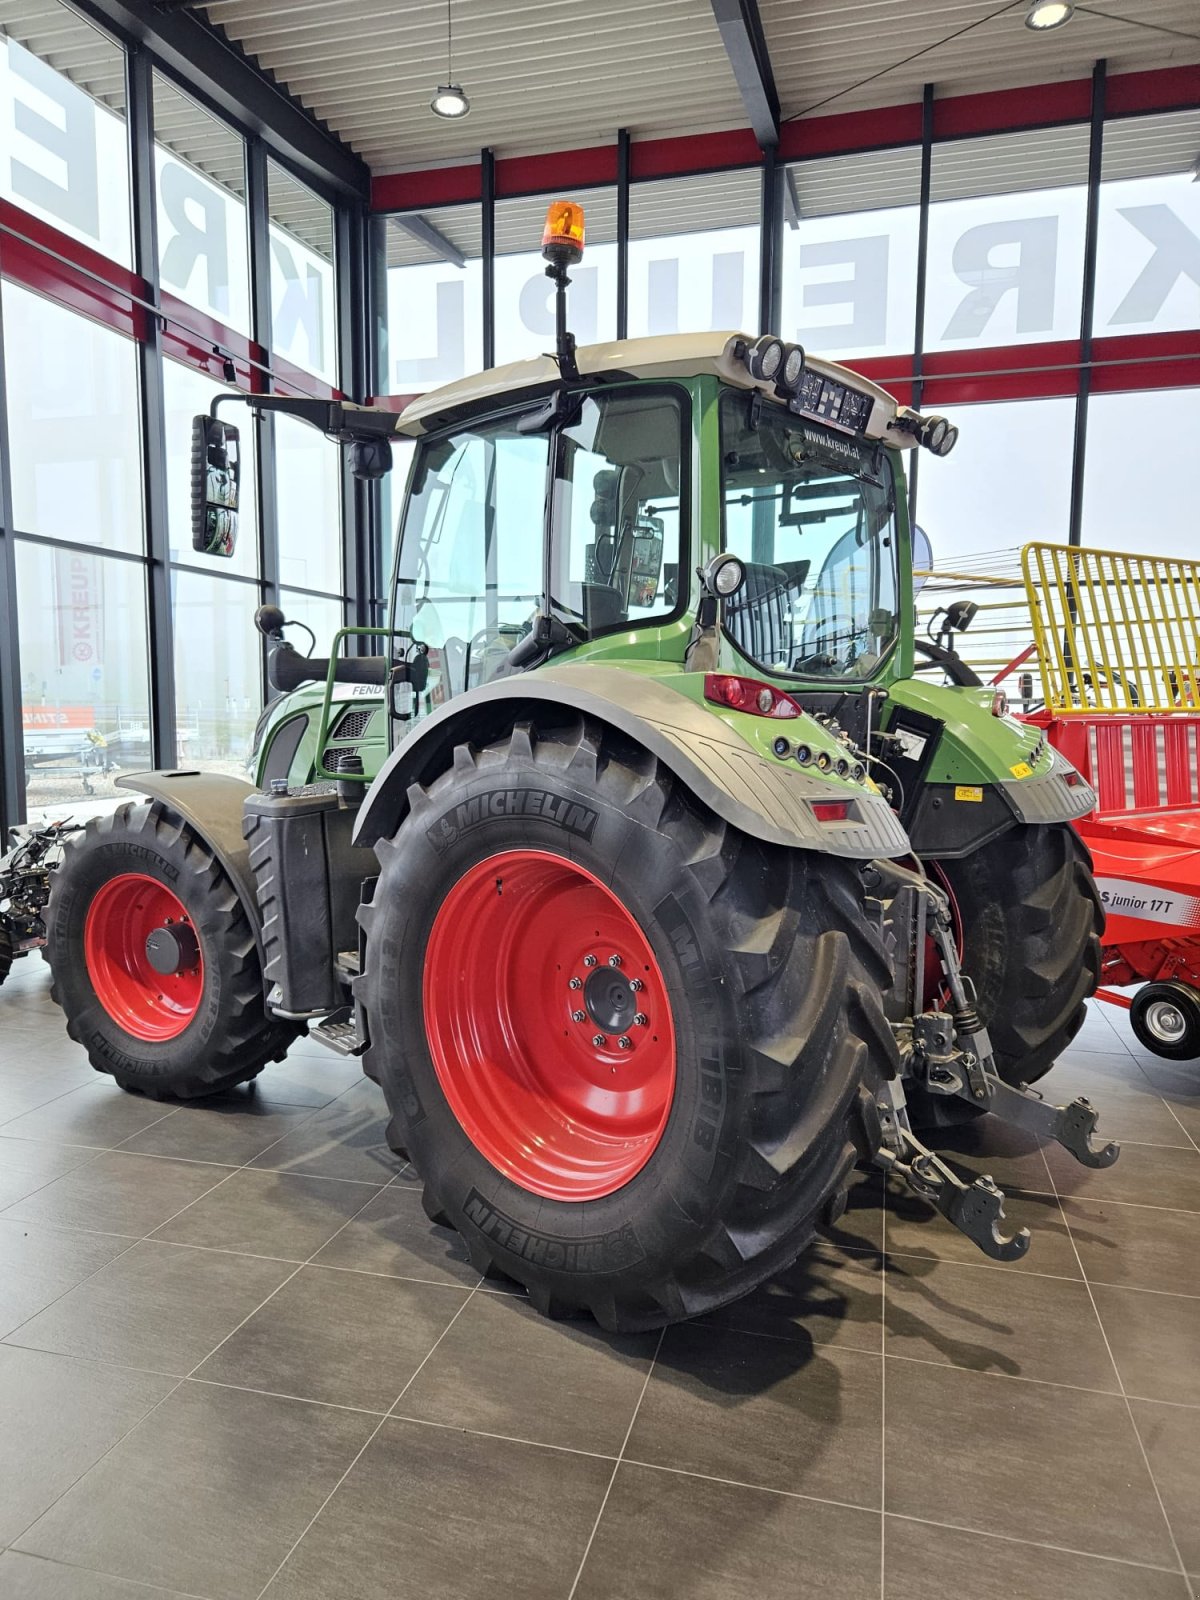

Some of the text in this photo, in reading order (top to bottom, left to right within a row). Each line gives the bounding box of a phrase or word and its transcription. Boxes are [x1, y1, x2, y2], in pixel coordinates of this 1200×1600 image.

[804, 429, 860, 460] www.kreupl.at
[352, 685, 385, 696] FEND
[457, 791, 594, 833] MICHELIN
[112, 843, 179, 882] MICHELIN
[1111, 892, 1148, 910] junior
[1150, 899, 1174, 914] 17T
[465, 1198, 600, 1273] MICHELIN
